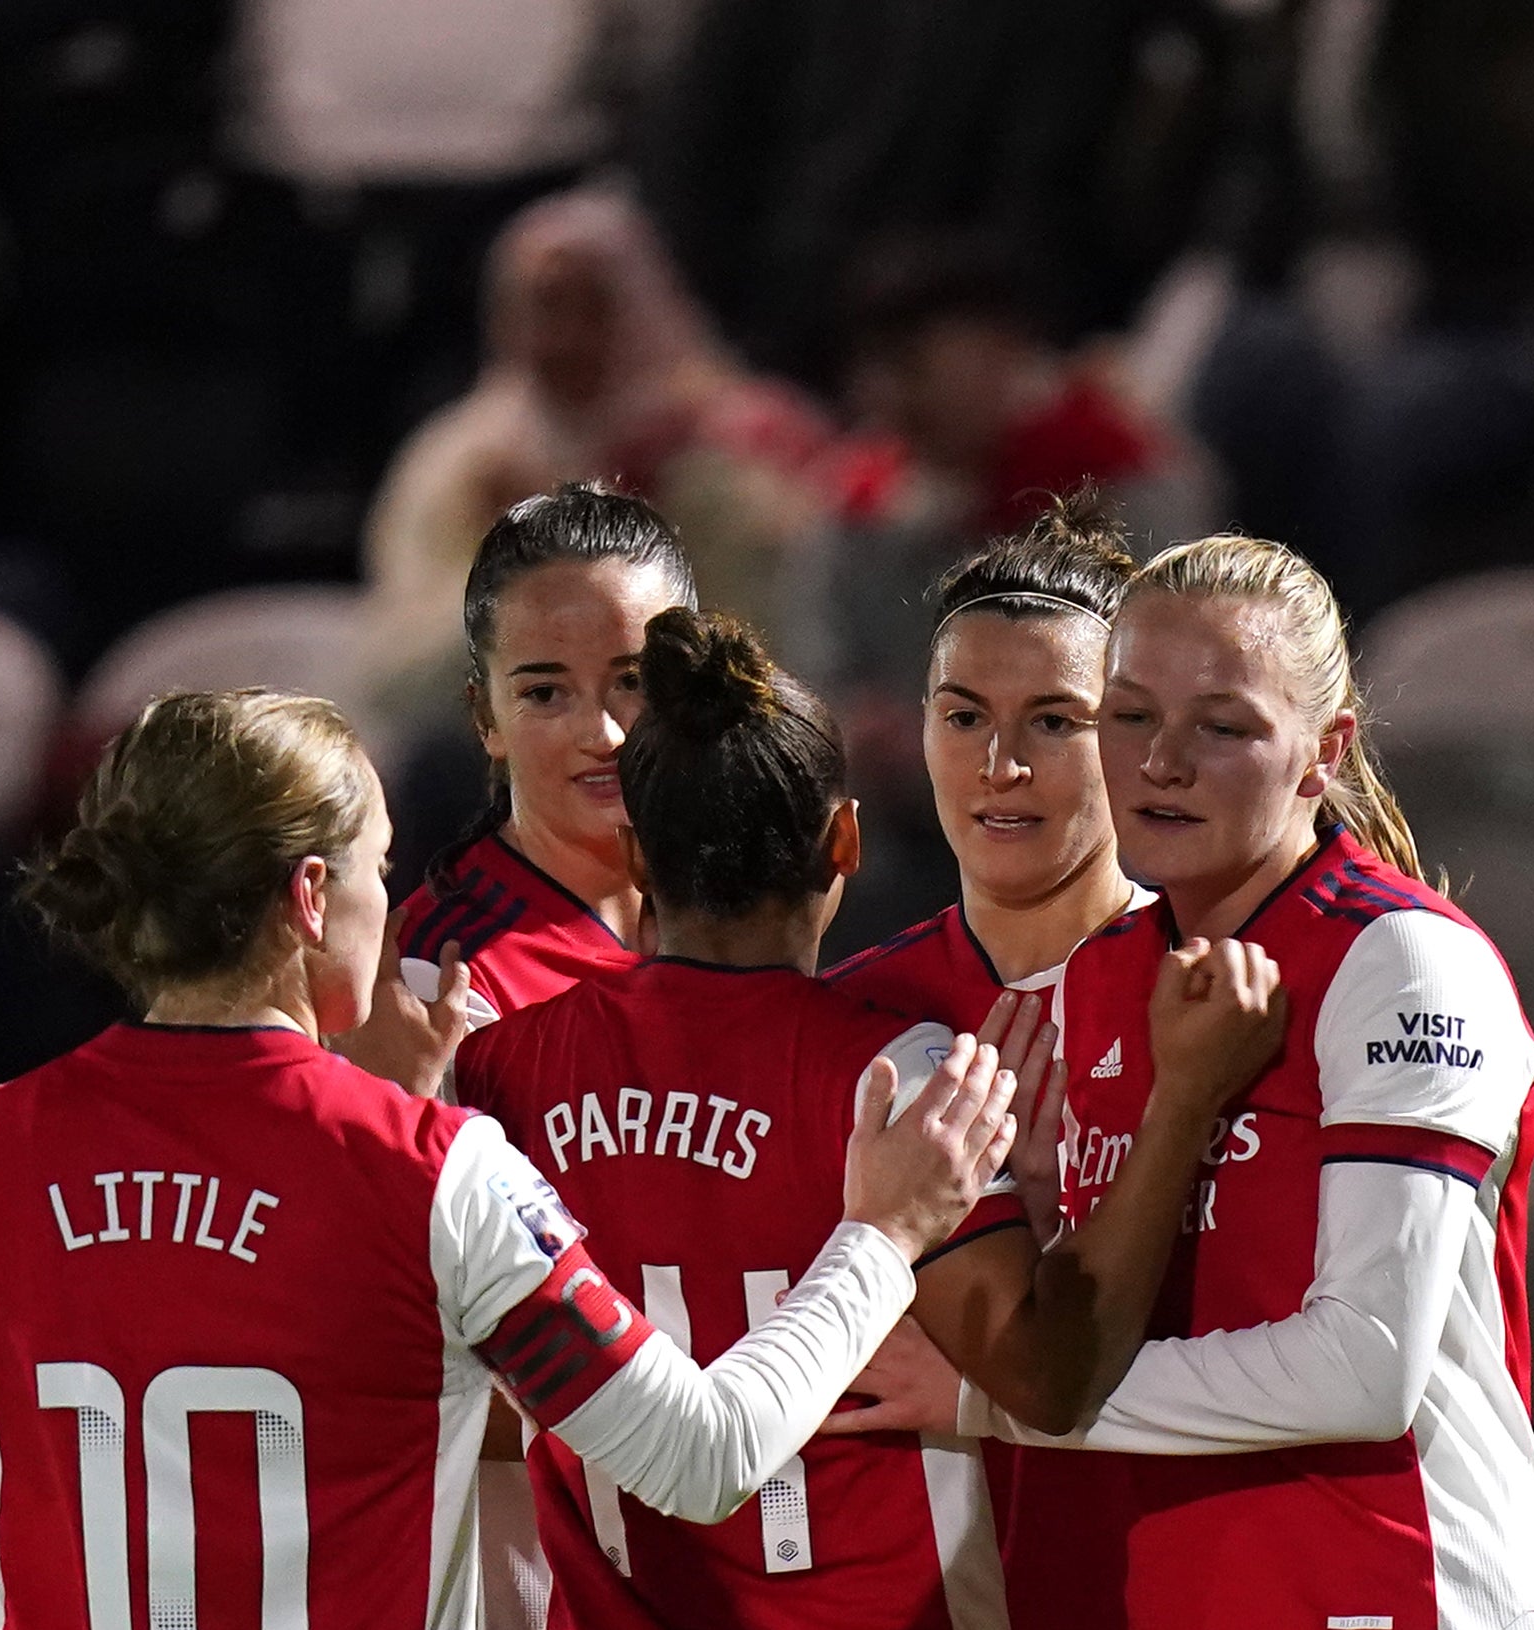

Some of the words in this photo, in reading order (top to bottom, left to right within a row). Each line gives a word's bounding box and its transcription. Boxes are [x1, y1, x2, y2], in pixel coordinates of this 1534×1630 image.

[1366, 1039, 1484, 1071] RWANDA
[1397, 1012, 1465, 1040] VISIT
[544, 1087, 772, 1180] PARRIS
[1078, 1112, 1261, 1188] Emes
[48, 1170, 279, 1263] LITTLE
